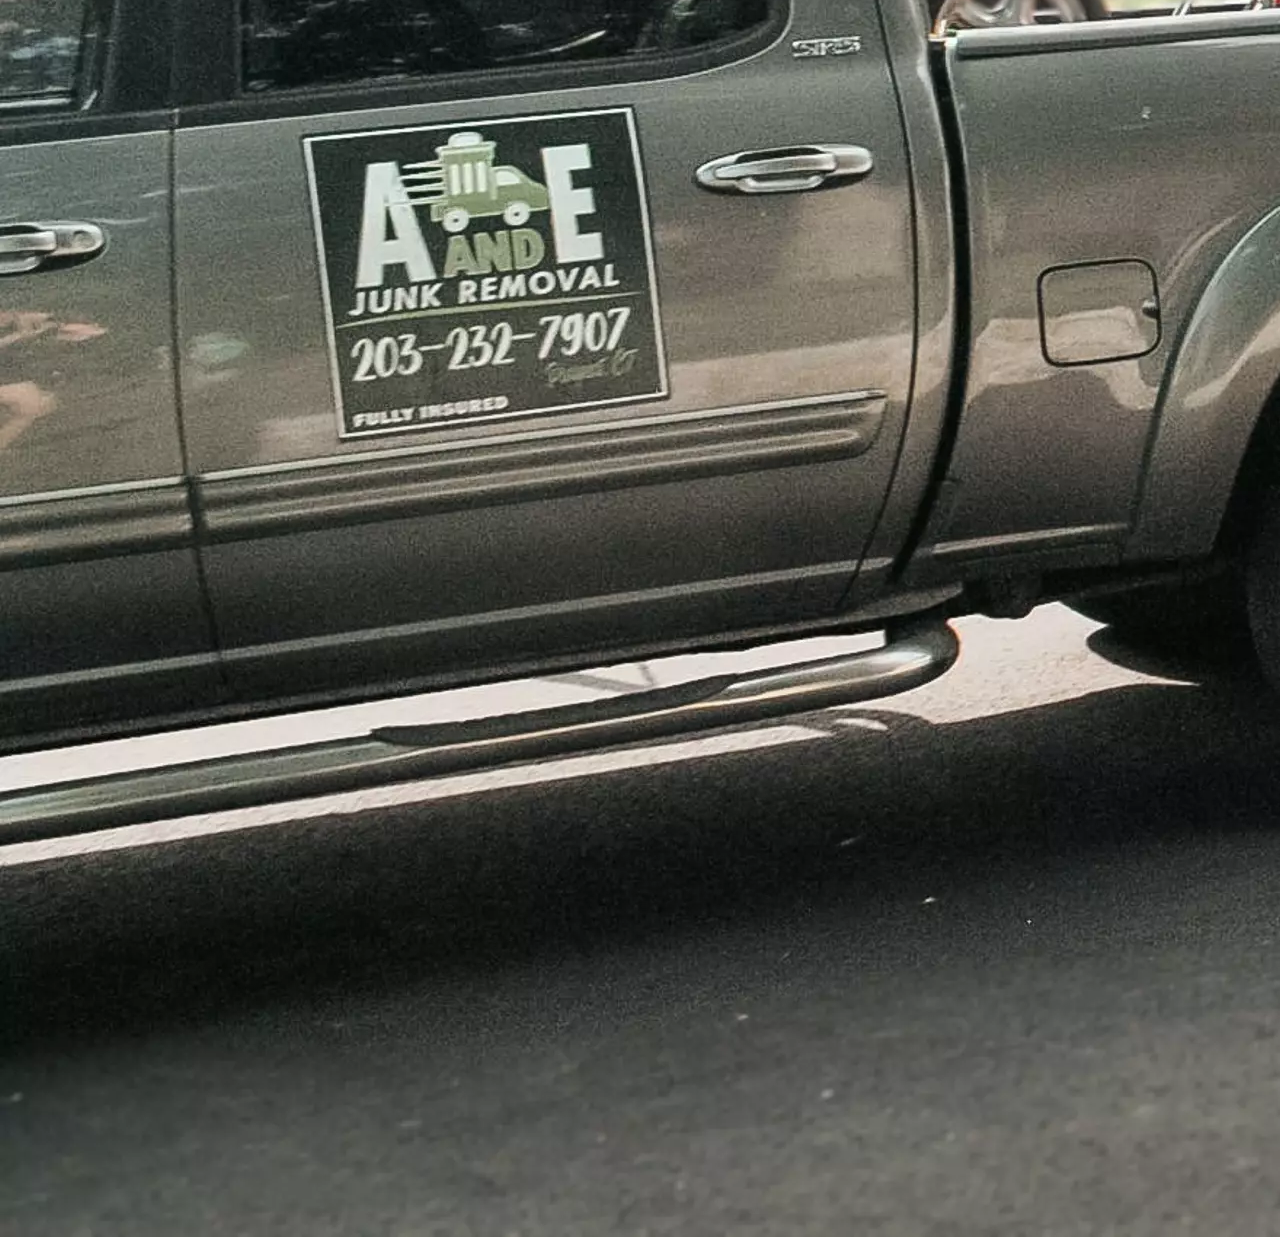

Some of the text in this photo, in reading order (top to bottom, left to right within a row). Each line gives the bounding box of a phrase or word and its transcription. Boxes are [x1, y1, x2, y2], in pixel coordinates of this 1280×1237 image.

[355, 143, 605, 288] A AND E
[348, 263, 620, 316] JUNK REMOVAL
[351, 306, 631, 382] 203-232-7907
[352, 396, 510, 428] FULLY INSURED
